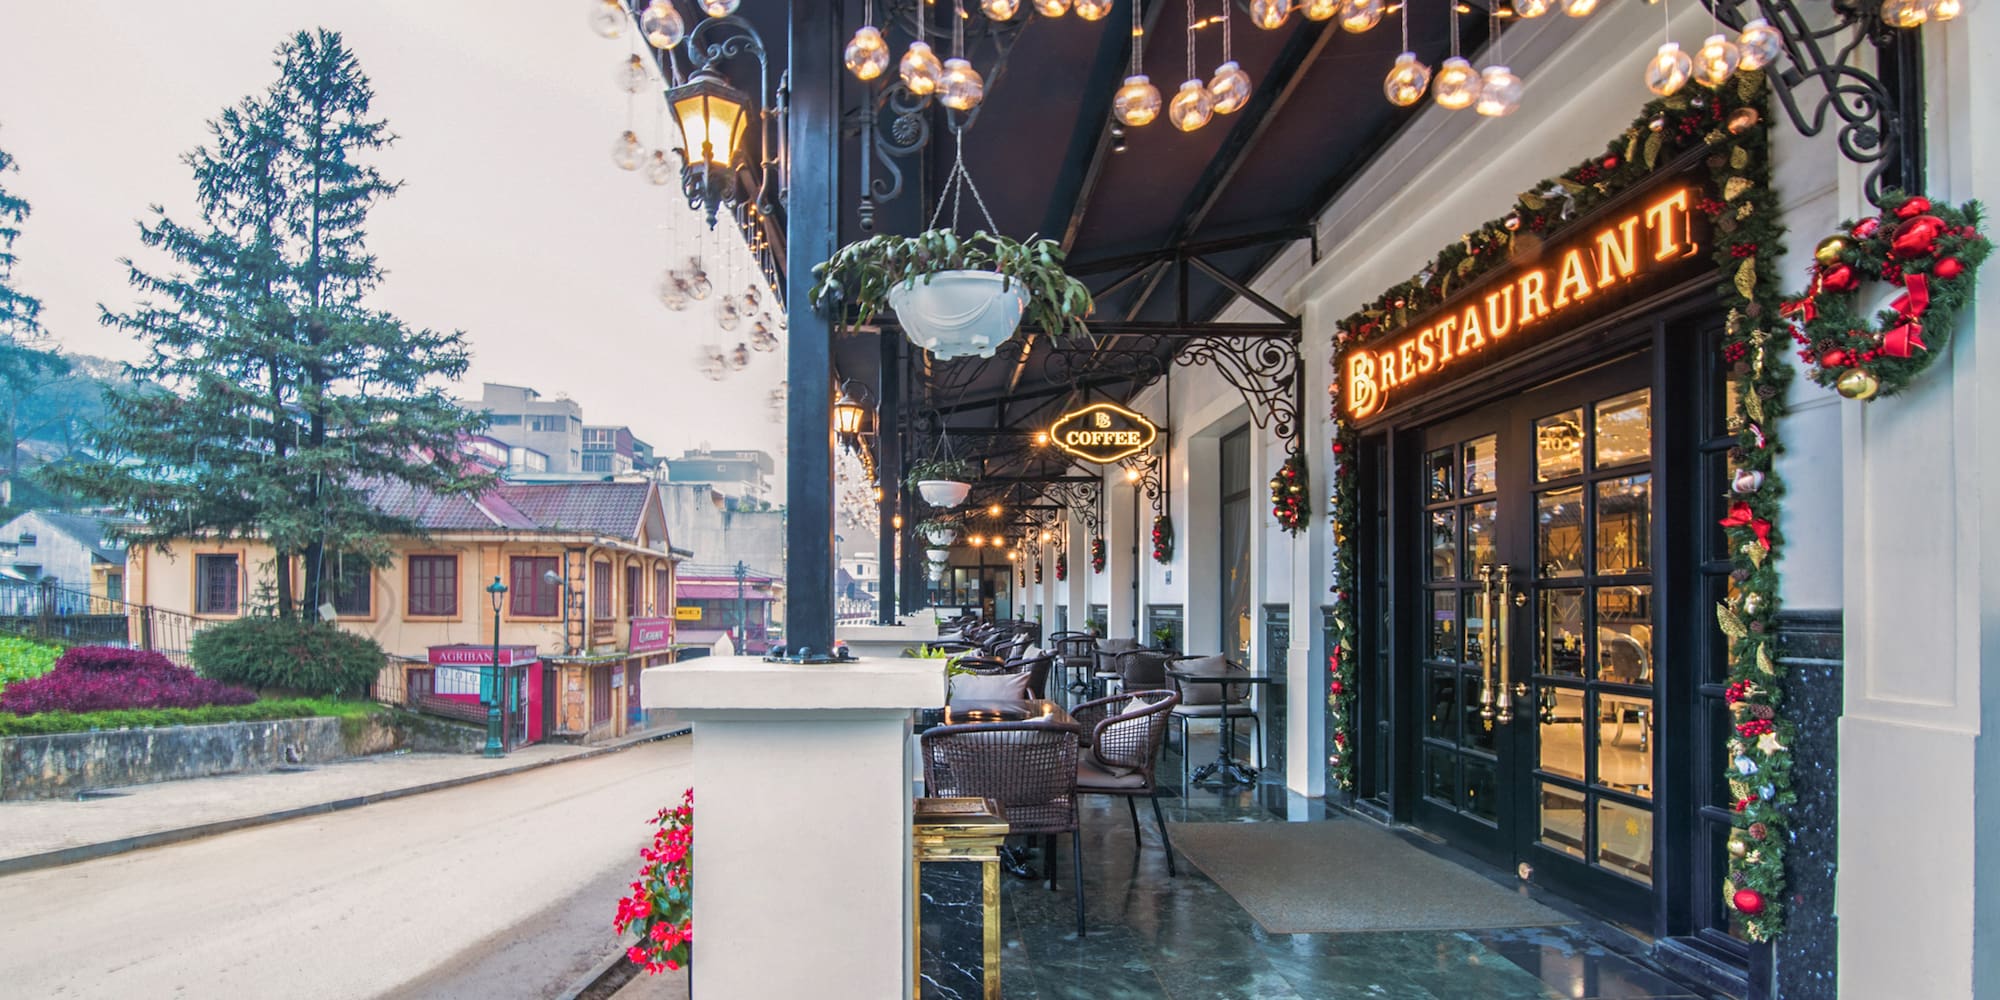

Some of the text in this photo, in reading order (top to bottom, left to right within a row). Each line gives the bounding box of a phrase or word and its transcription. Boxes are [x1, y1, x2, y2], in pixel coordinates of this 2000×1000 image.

[1379, 189, 1688, 393] RESTAURANT
[1066, 430, 1141, 446] COFFEE
[440, 651, 502, 662] AGRIBAN
